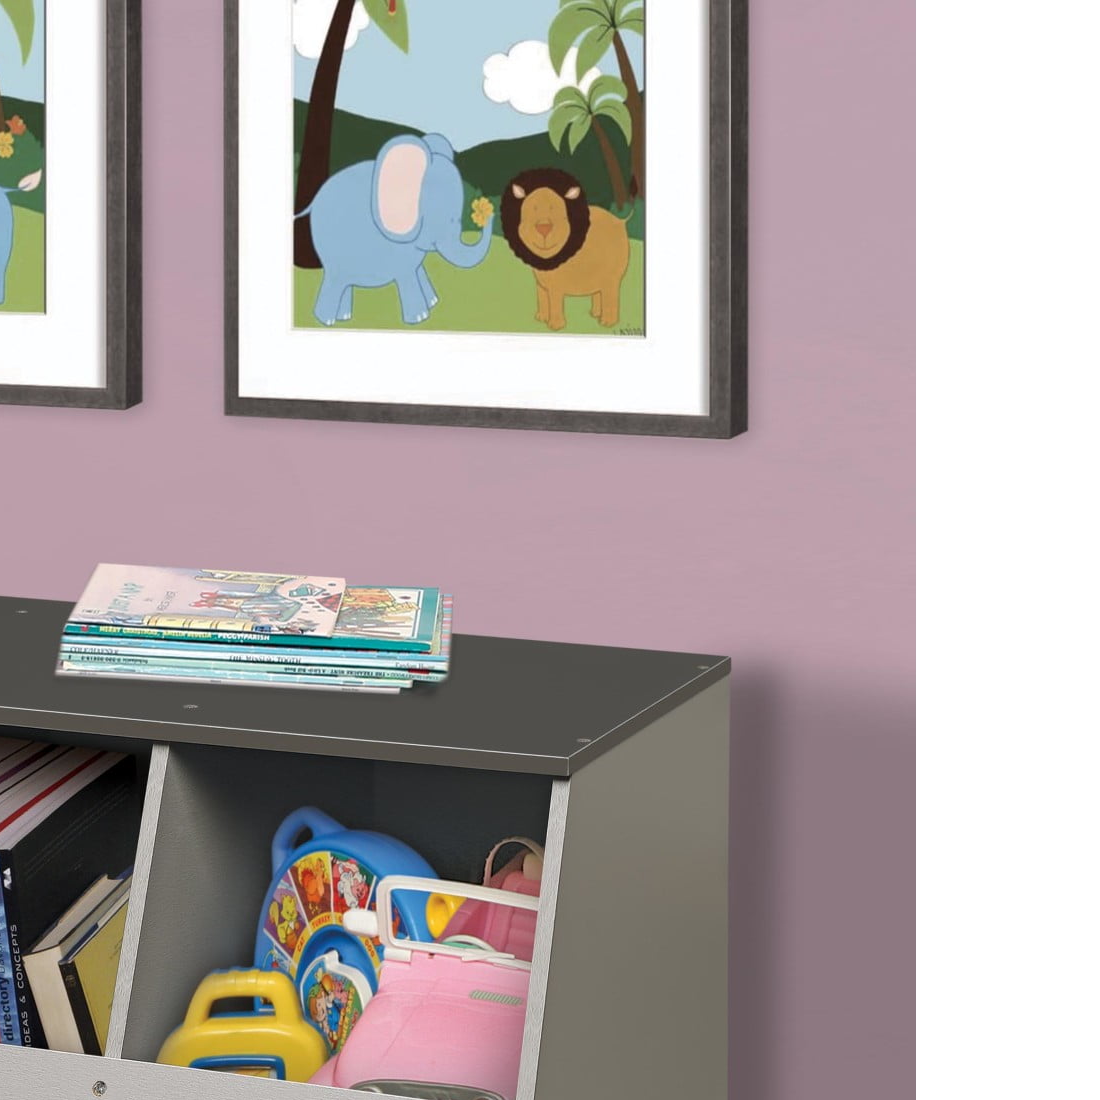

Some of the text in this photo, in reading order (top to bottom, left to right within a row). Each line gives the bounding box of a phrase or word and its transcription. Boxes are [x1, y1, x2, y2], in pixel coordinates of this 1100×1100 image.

[0, 977, 14, 1041] directory
[10, 924, 32, 1047] IDEAS & CONCEPTS
